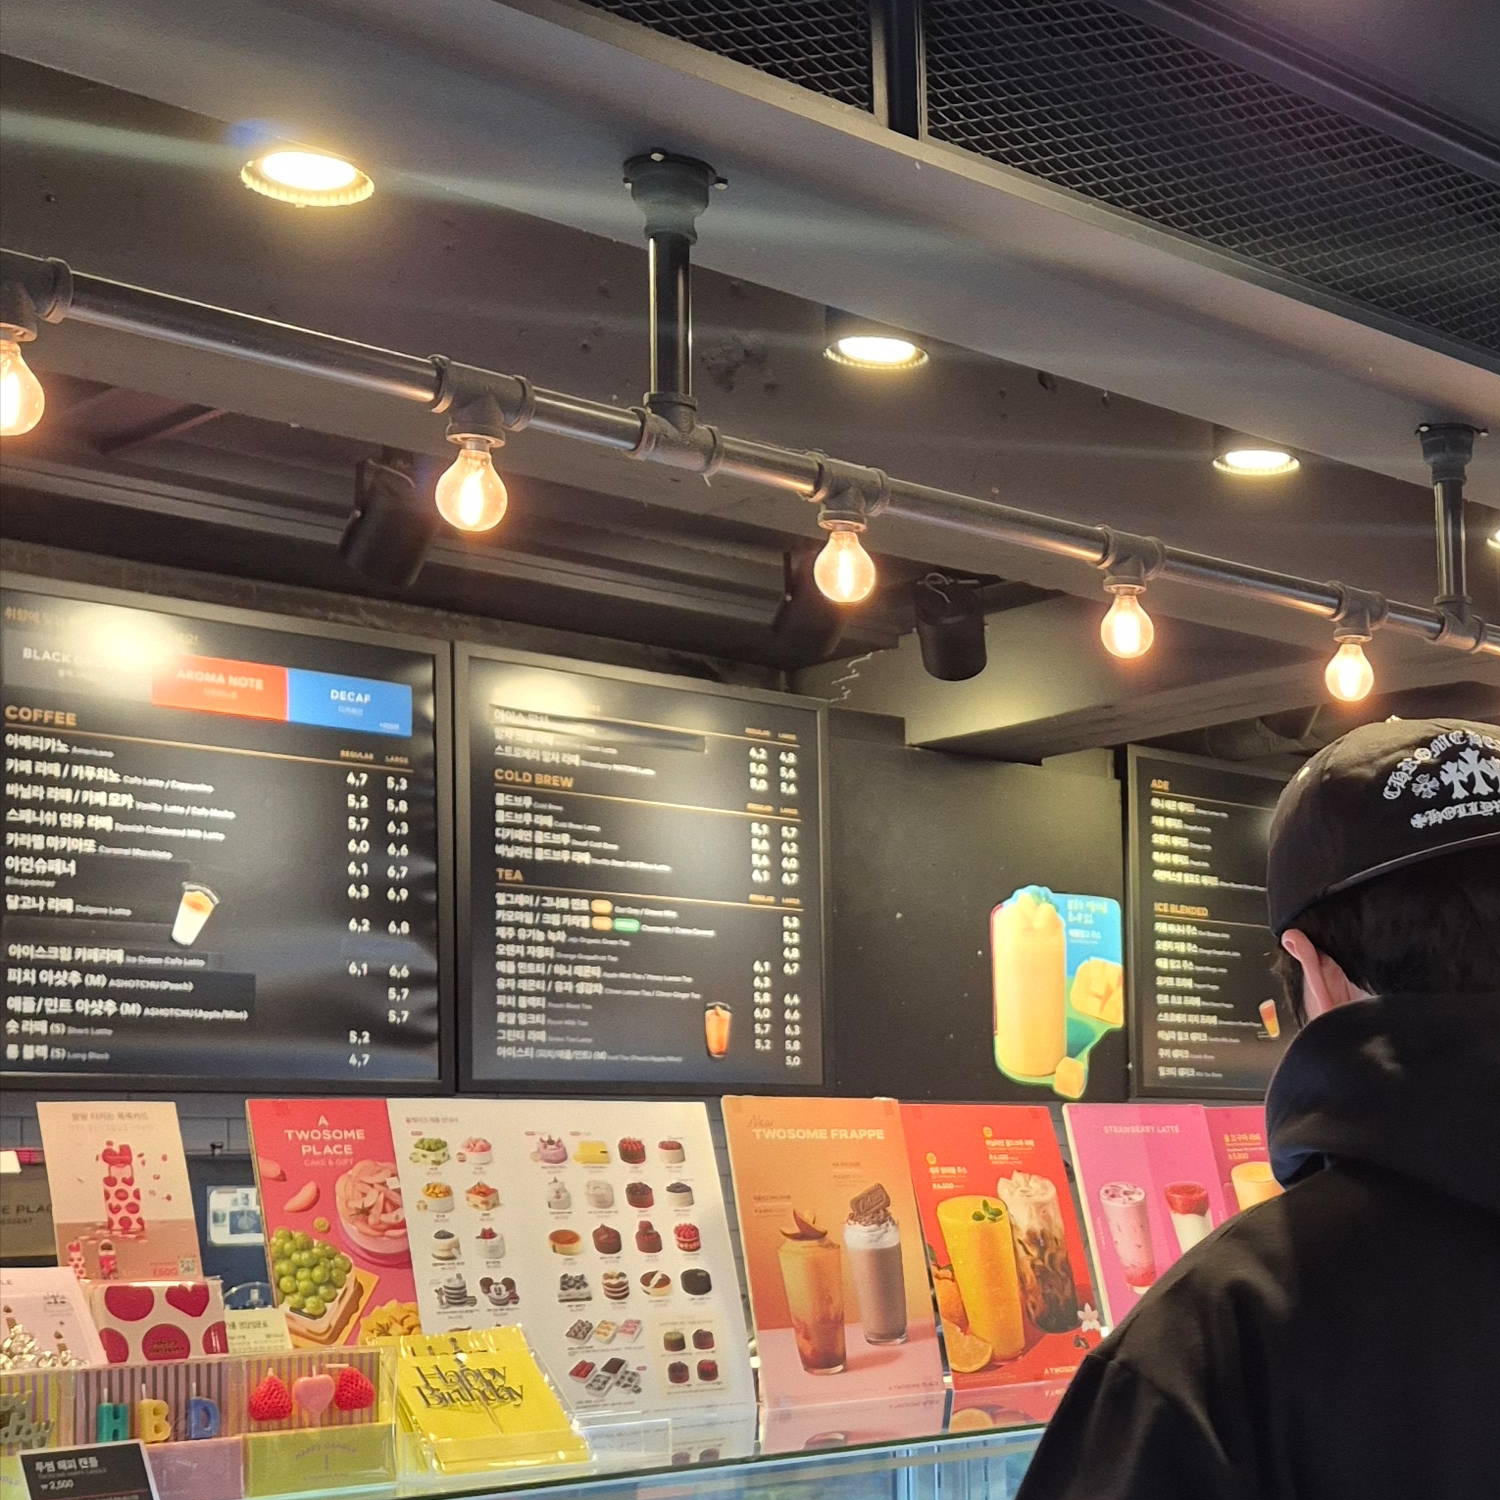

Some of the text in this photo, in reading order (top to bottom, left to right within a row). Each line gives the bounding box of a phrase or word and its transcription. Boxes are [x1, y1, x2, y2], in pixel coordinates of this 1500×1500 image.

[176, 668, 264, 692] AROMA NOTE
[330, 689, 372, 704] DECAF
[5, 705, 77, 728] COFFEE
[5, 733, 71, 753] 아메리카노
[494, 768, 574, 789] COLD BREW
[1151, 779, 1169, 790] ADE
[5, 855, 77, 878] 아인슈페너
[496, 868, 524, 880] TEA
[1154, 902, 1208, 916] ICE BLENDED
[8, 943, 73, 963] 아이스크림
[318, 1115, 329, 1127] A
[748, 1114, 775, 1128] New
[284, 1129, 365, 1140] TWOSOME
[752, 1128, 885, 1140] TWOSOME FRAPPE
[1103, 1125, 1180, 1134] STRAWBERRY LATTE
[301, 1144, 353, 1155] PLACE
[412, 1364, 507, 1396] Happy
[412, 1385, 524, 1409] Birthday
[138, 1398, 172, 1444] B
[187, 1396, 220, 1440] D
